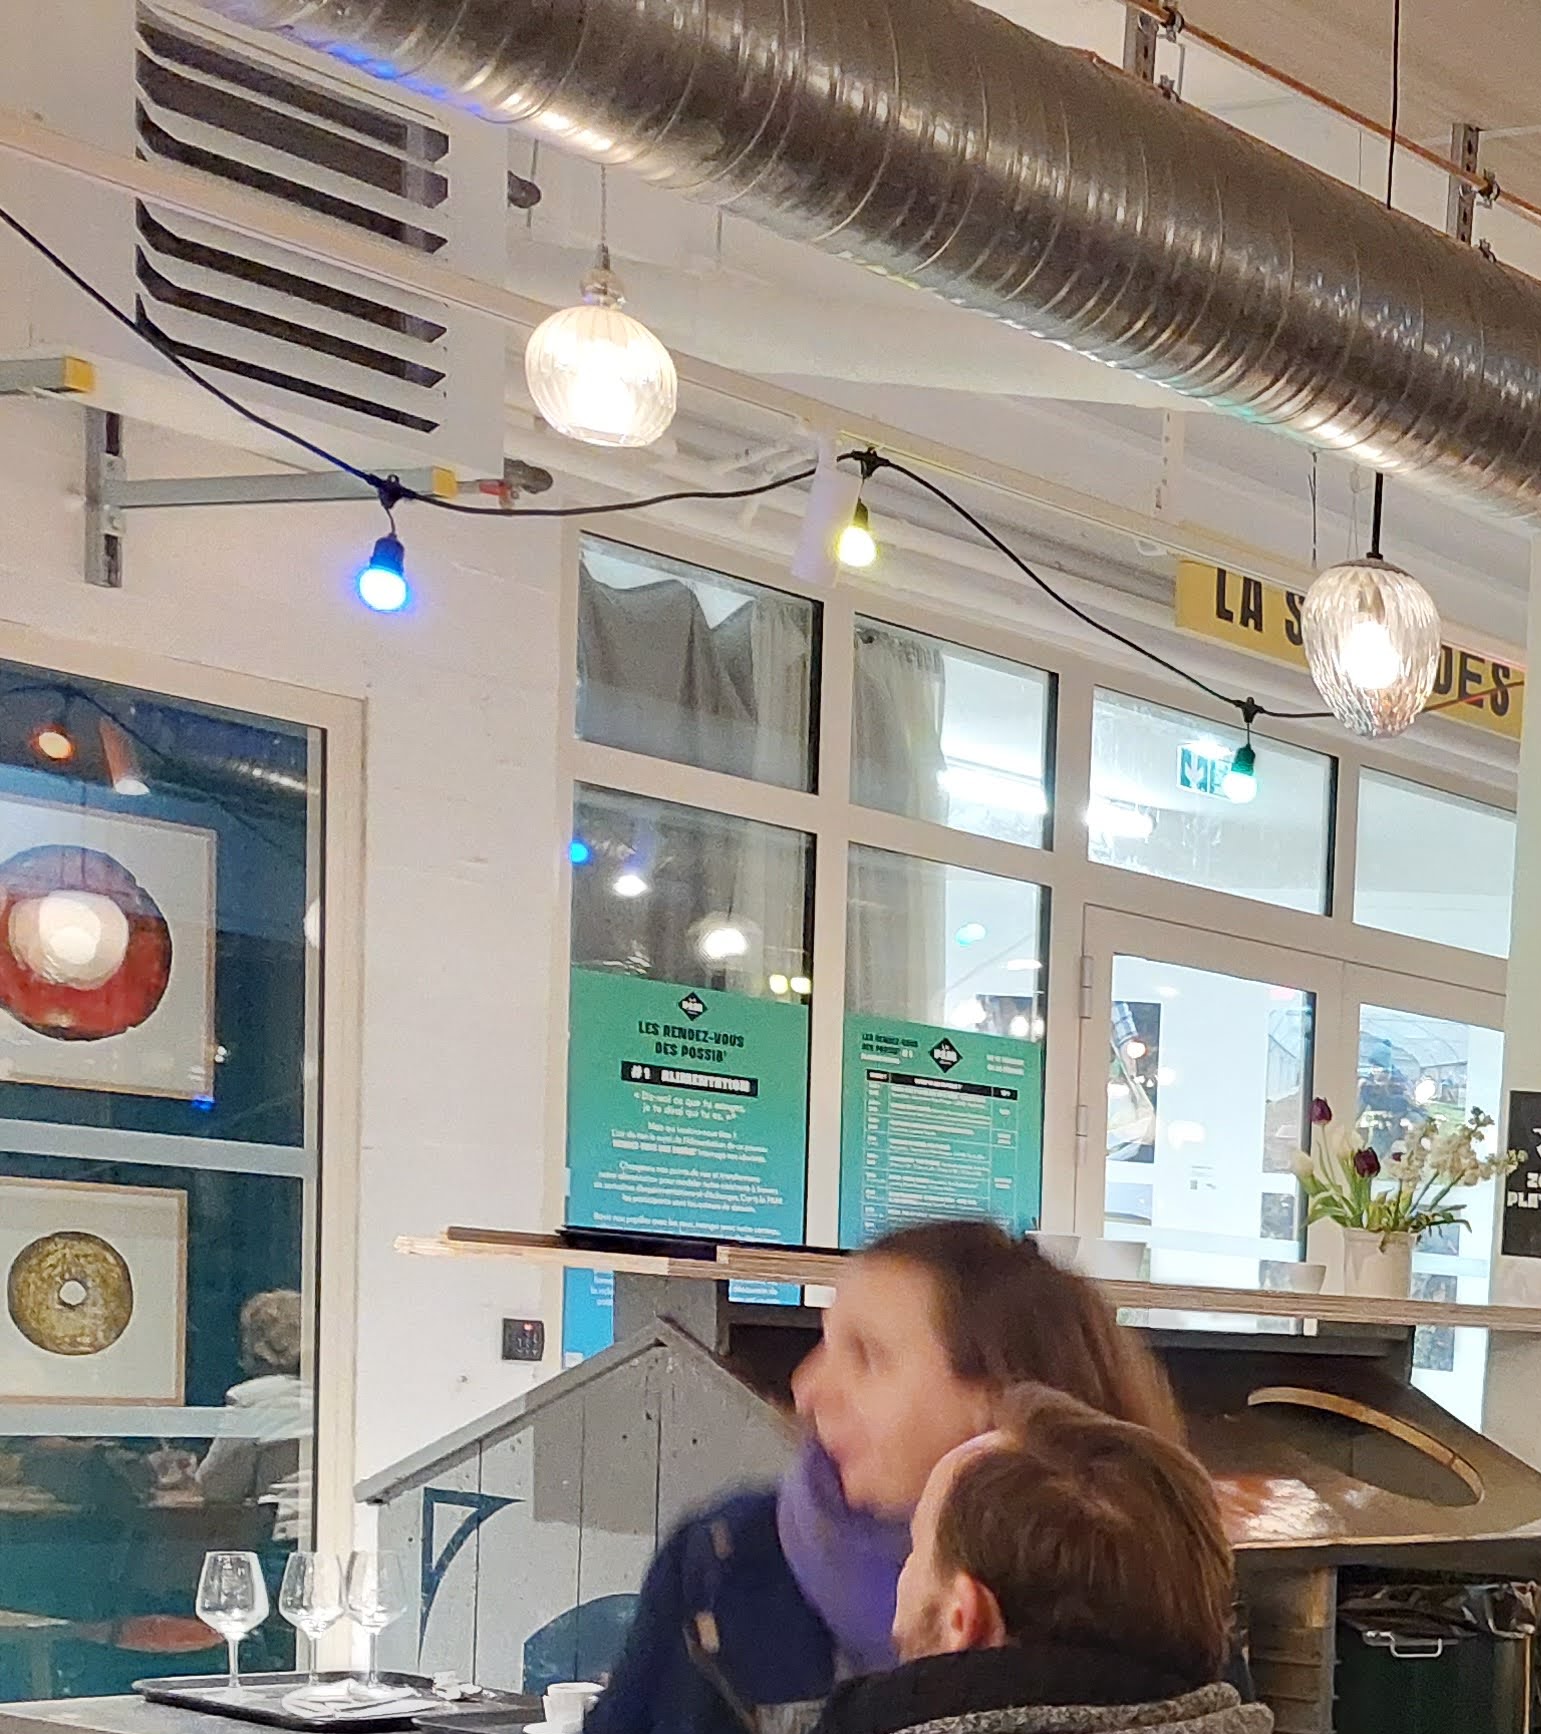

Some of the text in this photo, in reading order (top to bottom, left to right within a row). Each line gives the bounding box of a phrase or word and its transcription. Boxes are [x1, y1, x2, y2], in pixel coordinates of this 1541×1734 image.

[1215, 567, 1263, 632] LA
[638, 1020, 746, 1048] LES RENDEZ-VOUS
[655, 1041, 679, 1056] DES
